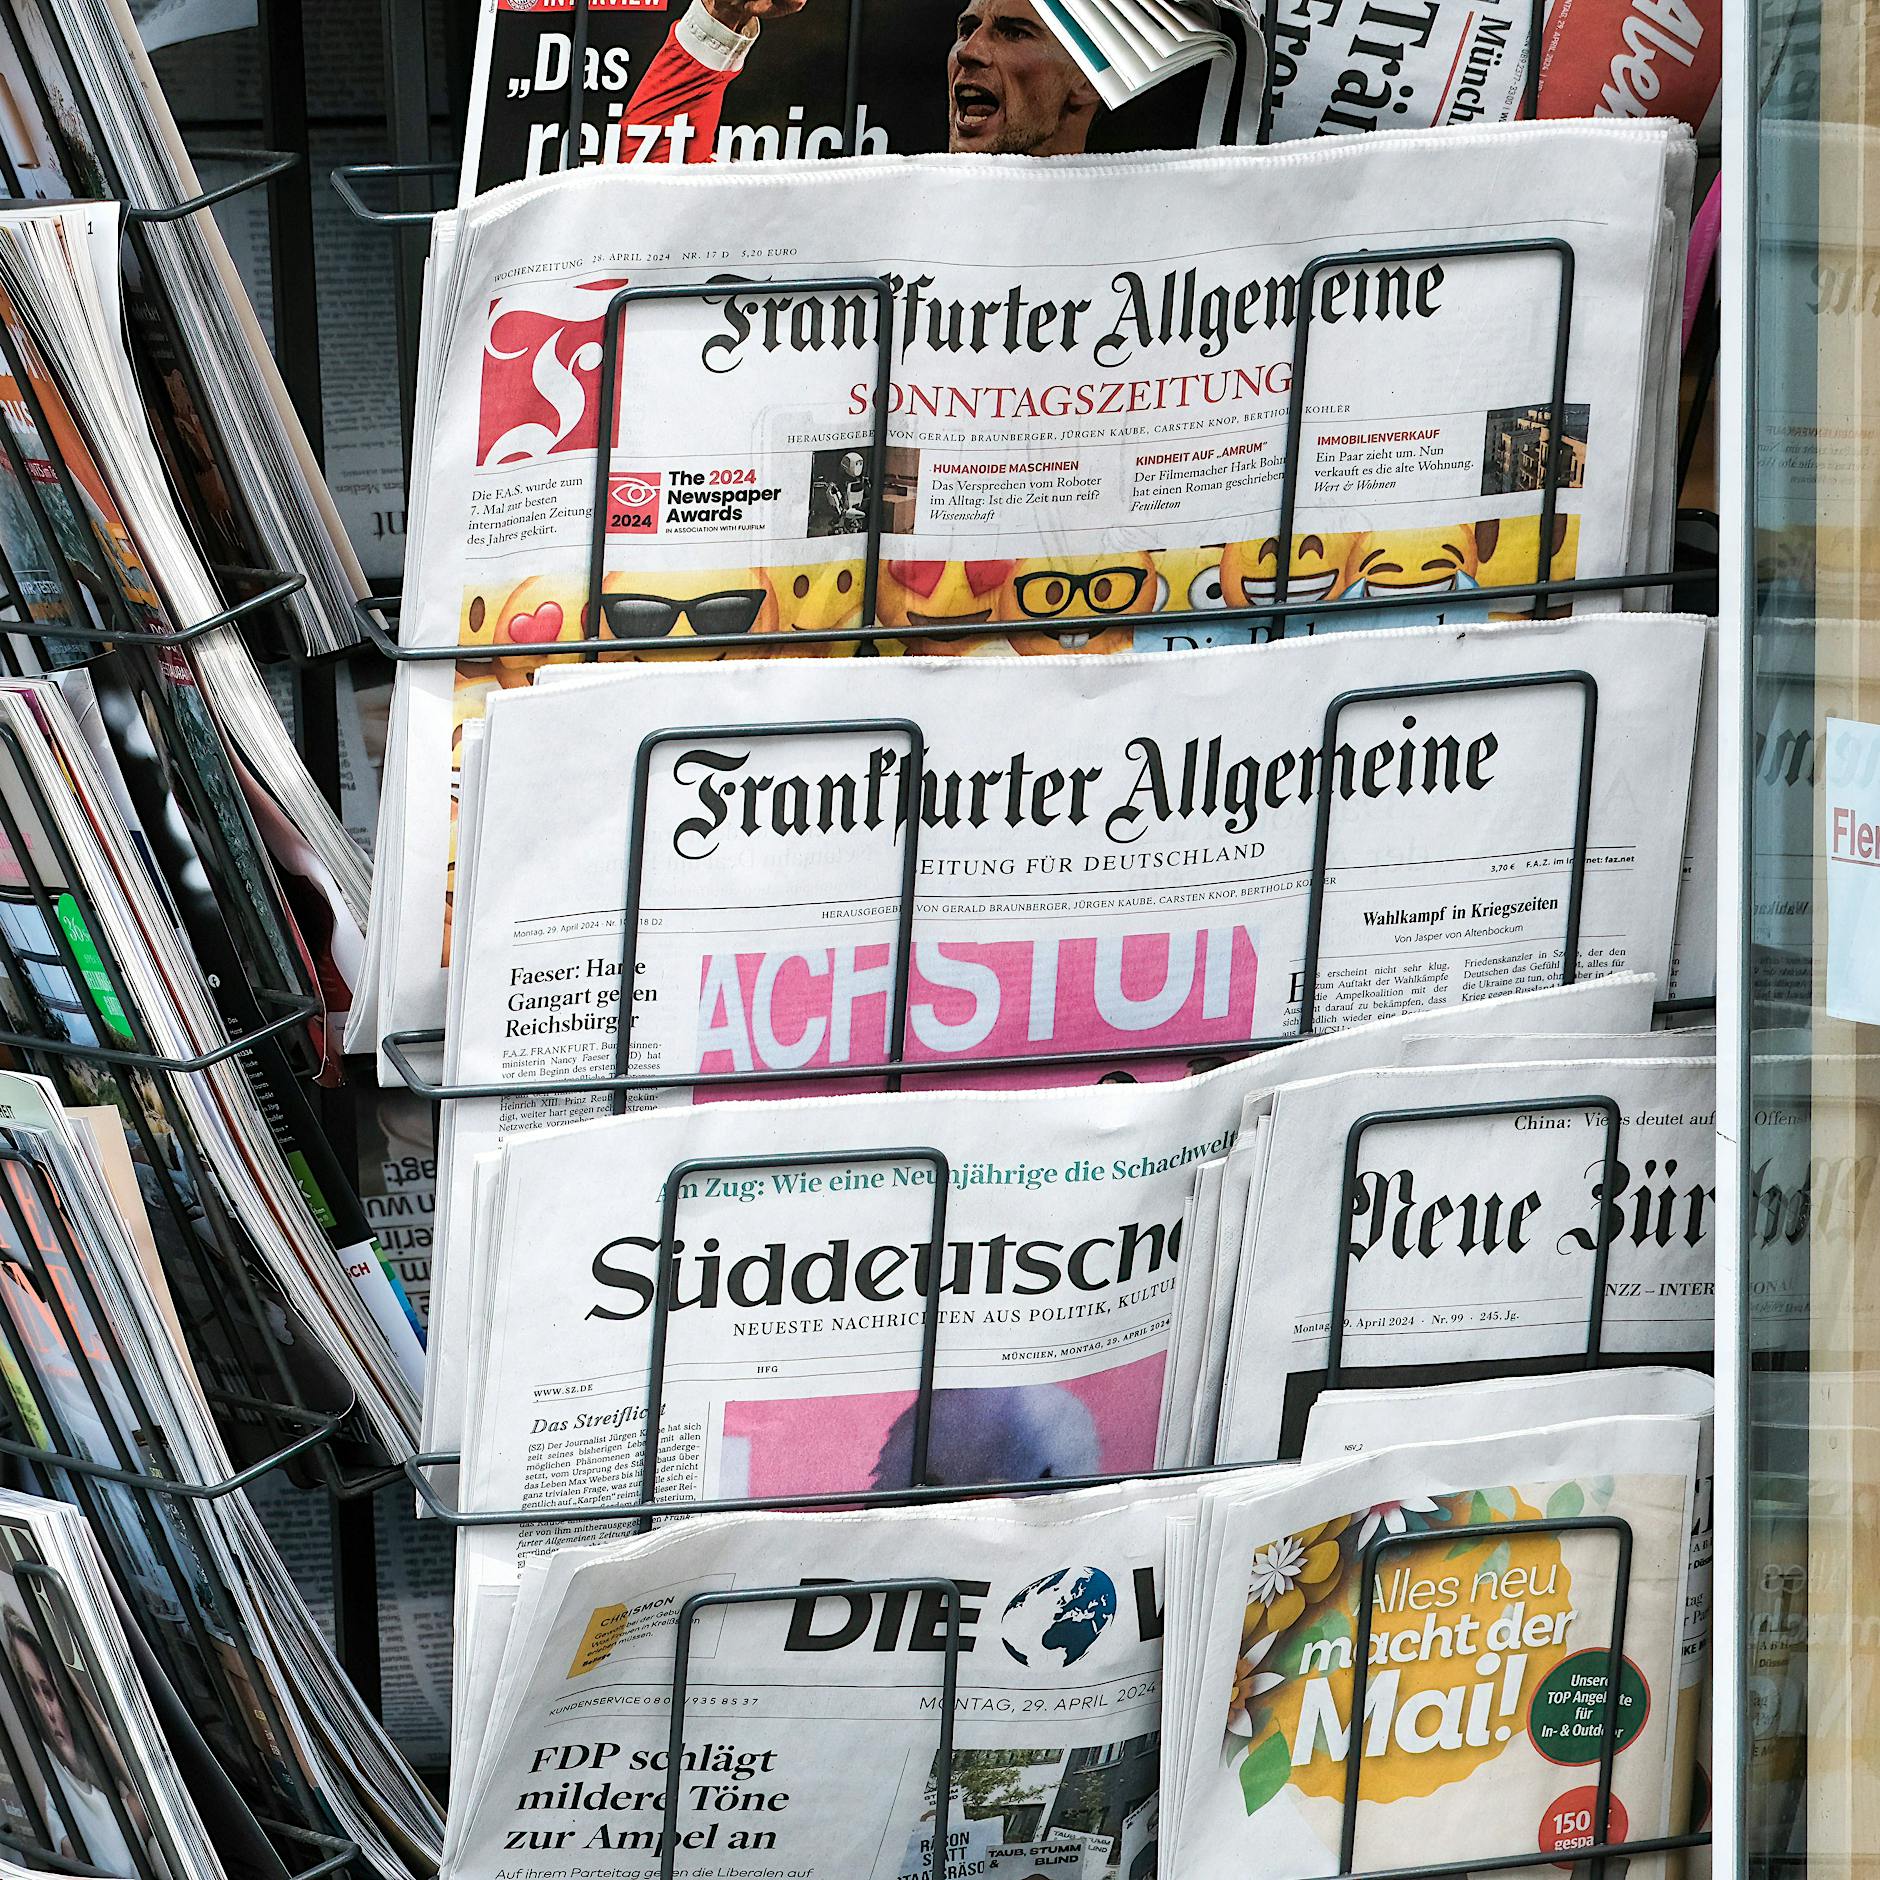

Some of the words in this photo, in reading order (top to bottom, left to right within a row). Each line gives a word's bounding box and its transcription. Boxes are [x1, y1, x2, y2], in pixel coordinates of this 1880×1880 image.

[494, 259, 583, 283] WOCHENZEITUNG
[609, 253, 642, 262] APRIL
[647, 253, 671, 262] 2024
[767, 247, 798, 257] EURO
[848, 361, 1294, 418] SONNTAGSZEITUNG
[919, 431, 966, 442] GERALD
[1061, 428, 1105, 440] JÜRGEN
[1154, 420, 1205, 434] CARSTEN
[1317, 429, 1441, 446] IMMOBILIENVERKAUF
[1136, 453, 1190, 467] KINDHEIT
[1192, 450, 1215, 462] AUF
[1316, 452, 1336, 463] Ein
[1338, 450, 1364, 462] Paar
[1366, 448, 1393, 460] zieht
[1419, 446, 1444, 457] Nun
[669, 471, 705, 486] The
[709, 468, 756, 486] 2024
[932, 463, 1006, 474] HUMANOIDE
[1009, 460, 1080, 473] MASCHINEN
[1134, 471, 1157, 483] Der
[1158, 465, 1229, 482] Filmemacher
[1231, 458, 1257, 472] Hark
[1315, 463, 1360, 478] verkauft
[1418, 458, 1475, 474] Wohnung.
[525, 479, 557, 493] wurde
[560, 477, 584, 488] zum
[932, 479, 954, 491] Das
[956, 478, 1027, 493] Versprechen
[1030, 480, 1054, 490] vom
[1057, 475, 1103, 487] Roboter
[1153, 485, 1185, 495] einen
[1186, 480, 1223, 494] Roman
[1225, 470, 1284, 491] geschrieben
[1355, 479, 1397, 492] Wohnen
[524, 494, 557, 508] besten
[667, 486, 782, 509] Newspaper
[948, 494, 985, 508] Alltag:
[1026, 492, 1049, 504] Zeit
[1131, 499, 1181, 513] Feuilleton
[468, 510, 547, 531] internationalen
[549, 505, 593, 520] Zeitung
[611, 514, 653, 528] 2024
[666, 505, 743, 523] Awards
[930, 508, 995, 522] Wissenschaft
[485, 530, 518, 547] Jahres
[519, 525, 557, 541] gekürt.
[673, 746, 1103, 860] Frankfurter
[1105, 715, 1499, 844] Allgemeine
[916, 858, 1015, 876] EITUNG
[1025, 855, 1073, 874] FÜR
[1084, 842, 1266, 872] DEUTSCHLAND
[916, 904, 939, 913] VON
[941, 903, 987, 913] GERALD
[1074, 897, 1116, 910] JÜRGEN
[1159, 891, 1206, 905] CARSTEN
[1241, 881, 1295, 897] BERTHOLD
[1362, 906, 1447, 927] Wahlkampf
[1452, 906, 1466, 920] in
[1471, 896, 1559, 919] Kriegszeiten
[1394, 934, 1413, 943] Von
[1414, 931, 1443, 943] Jasper
[1464, 923, 1524, 938] Altenbockum
[510, 964, 581, 987] Faeser:
[586, 958, 647, 978] Hare
[1327, 968, 1368, 979] erscheint
[508, 988, 592, 1012] Gangart
[596, 988, 658, 1009] geen
[505, 1012, 640, 1038] Reichsbürgr
[1514, 1115, 1572, 1131] China:
[1636, 1110, 1684, 1126] deutet
[1690, 1110, 1717, 1126] auf
[705, 1177, 765, 1203] Zug:
[771, 1171, 822, 1195] Wie
[829, 1169, 885, 1191] eine
[1065, 1160, 1105, 1182] die
[1347, 1169, 1542, 1263] Neue
[733, 1319, 824, 1337] NEUESTE
[832, 1309, 976, 1332] NACHRICTEN
[984, 1309, 1021, 1324] AUS
[1029, 1301, 1112, 1322] POLITIK,
[1356, 1317, 1386, 1329] April
[1389, 1316, 1415, 1327] 2024
[1061, 1341, 1105, 1356] MONTAG,
[1123, 1328, 1149, 1342] APRIL
[757, 1365, 778, 1374] HFG
[533, 1383, 594, 1398] WWW.SZ.DE
[530, 1418, 569, 1435] Das
[573, 1403, 666, 1429] Streiflict
[1354, 1566, 1460, 1616] Alles
[1471, 1563, 1556, 1602] neu
[600, 1595, 676, 1627] CHRISMON
[783, 1576, 992, 1652] DIE
[1298, 1611, 1480, 1675] macht
[1487, 1602, 1579, 1649] der
[1022, 1699, 1048, 1713] 29.
[1054, 1695, 1109, 1711] APRIL
[1117, 1681, 1157, 1703] 2024
[1548, 1691, 1571, 1704] TOP
[1572, 1690, 1633, 1707] Angete
[1291, 1653, 1529, 1767] Mai!
[1575, 1707, 1593, 1720] für
[528, 1742, 621, 1774] FDP
[629, 1743, 778, 1780] schlägt
[515, 1781, 668, 1811] mildere
[689, 1785, 790, 1811] Töne
[1553, 1810, 1591, 1835] 150
[503, 1830, 576, 1850] zur
[727, 1830, 777, 1850] an
[1029, 1843, 1082, 1855] STUMM
[1034, 1855, 1079, 1867] BLIND
[495, 1868, 523, 1880] Auf
[525, 1868, 567, 1879] ihrem
[570, 1868, 640, 1880] Parteitag
[692, 1867, 713, 1878] die
[717, 1867, 784, 1878] Liberalen
[787, 1867, 814, 1878] auf
